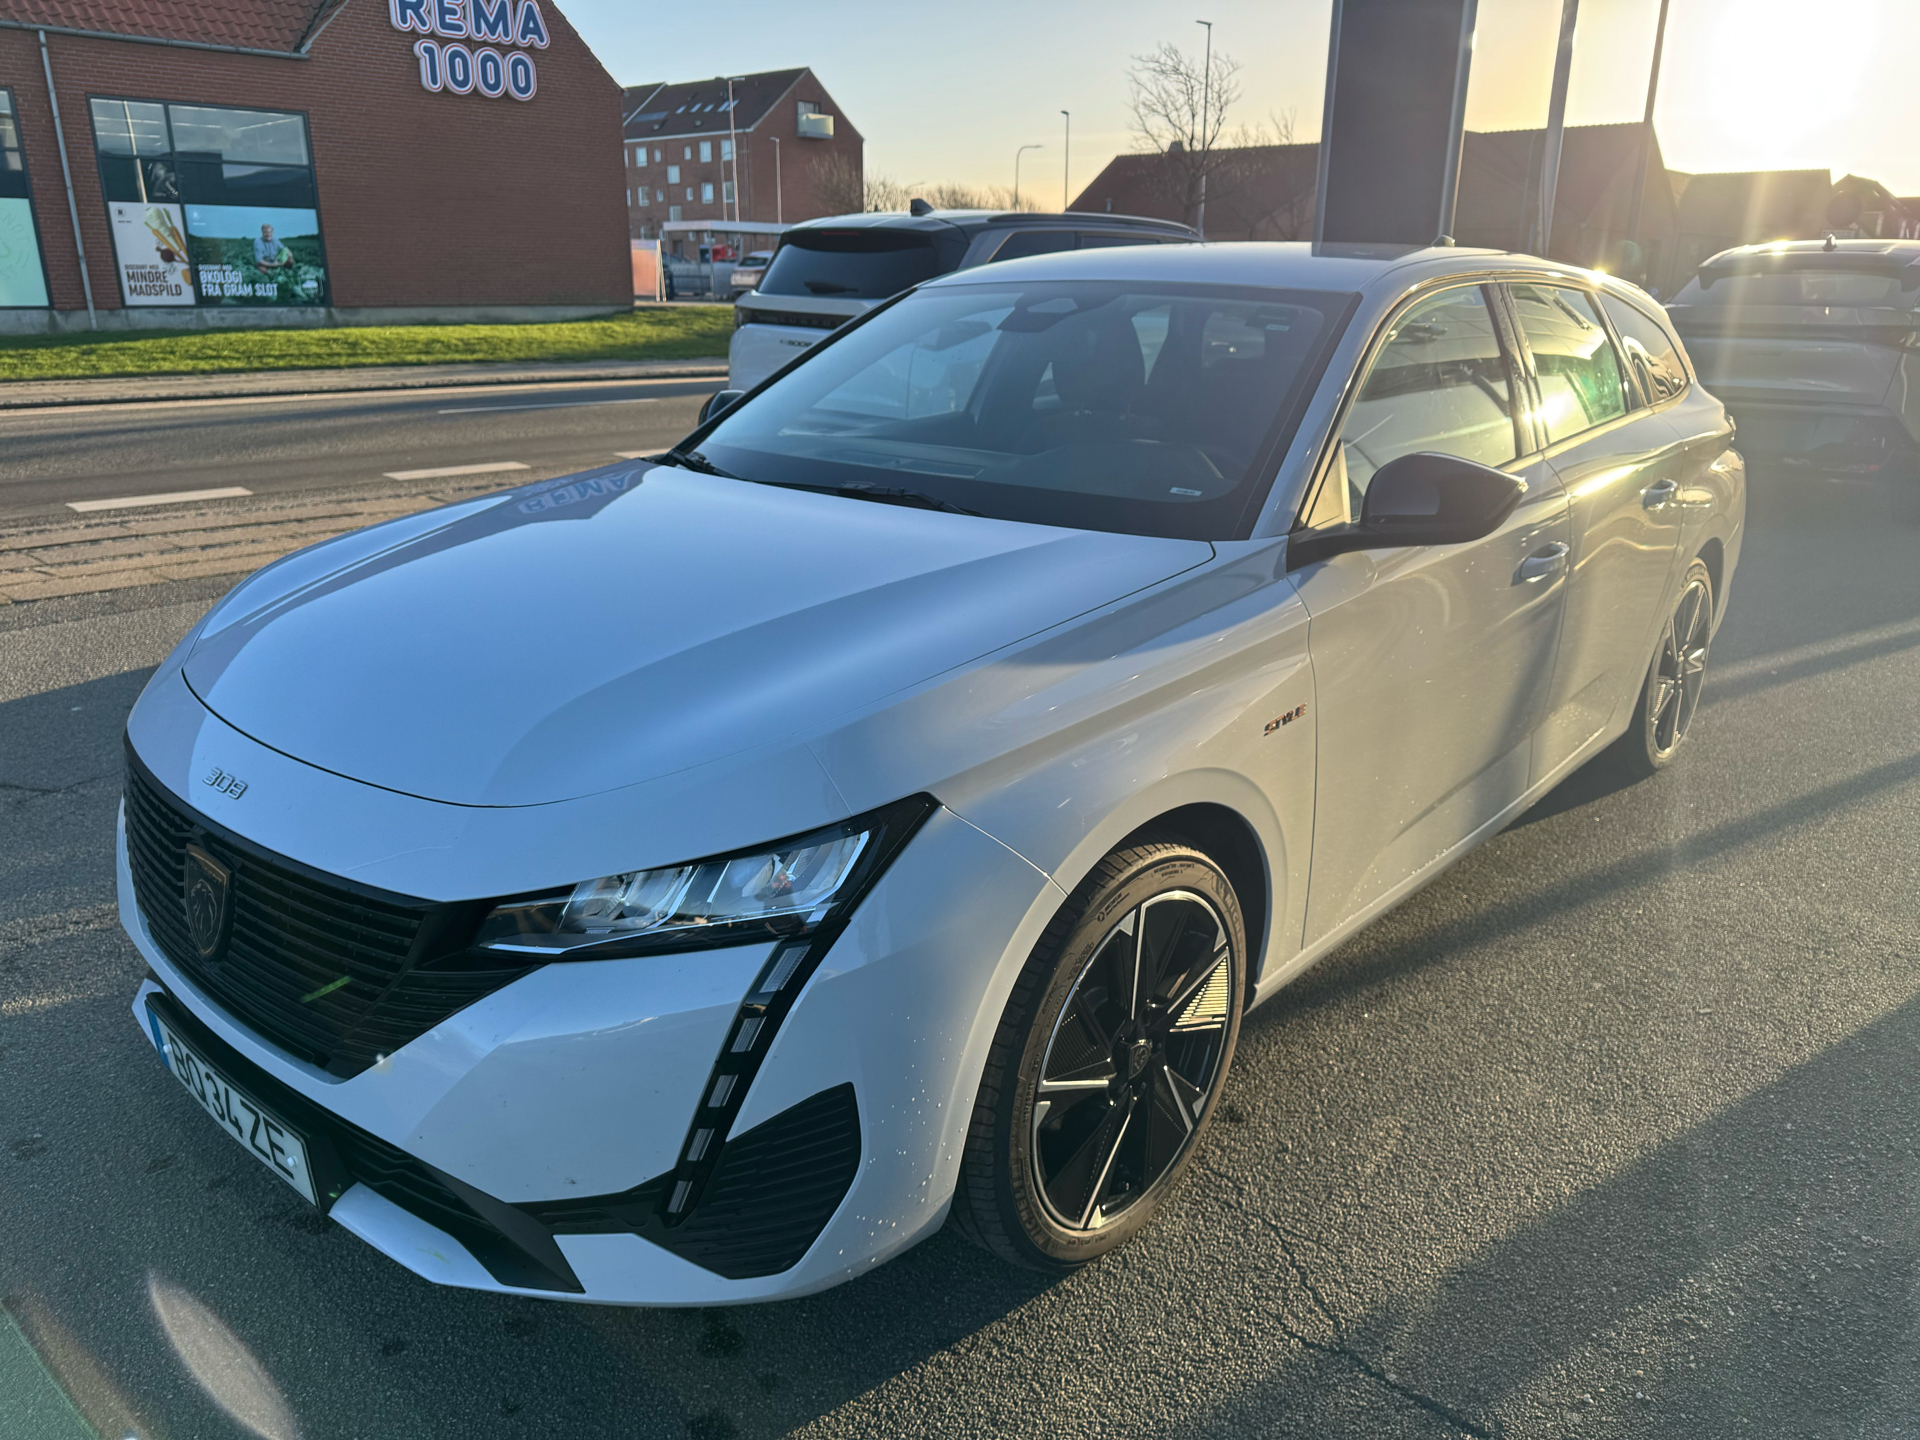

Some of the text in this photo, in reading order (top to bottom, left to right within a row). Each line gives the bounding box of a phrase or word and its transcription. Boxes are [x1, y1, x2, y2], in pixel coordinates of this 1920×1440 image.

[389, 0, 550, 49] REMA
[413, 39, 537, 101] 1000
[126, 270, 168, 283] MINDRE
[199, 271, 243, 284] ØKOLOGI
[128, 283, 182, 297] MADSPILD
[201, 283, 278, 297] FRA GRAM SLOT
[202, 767, 248, 800] 308
